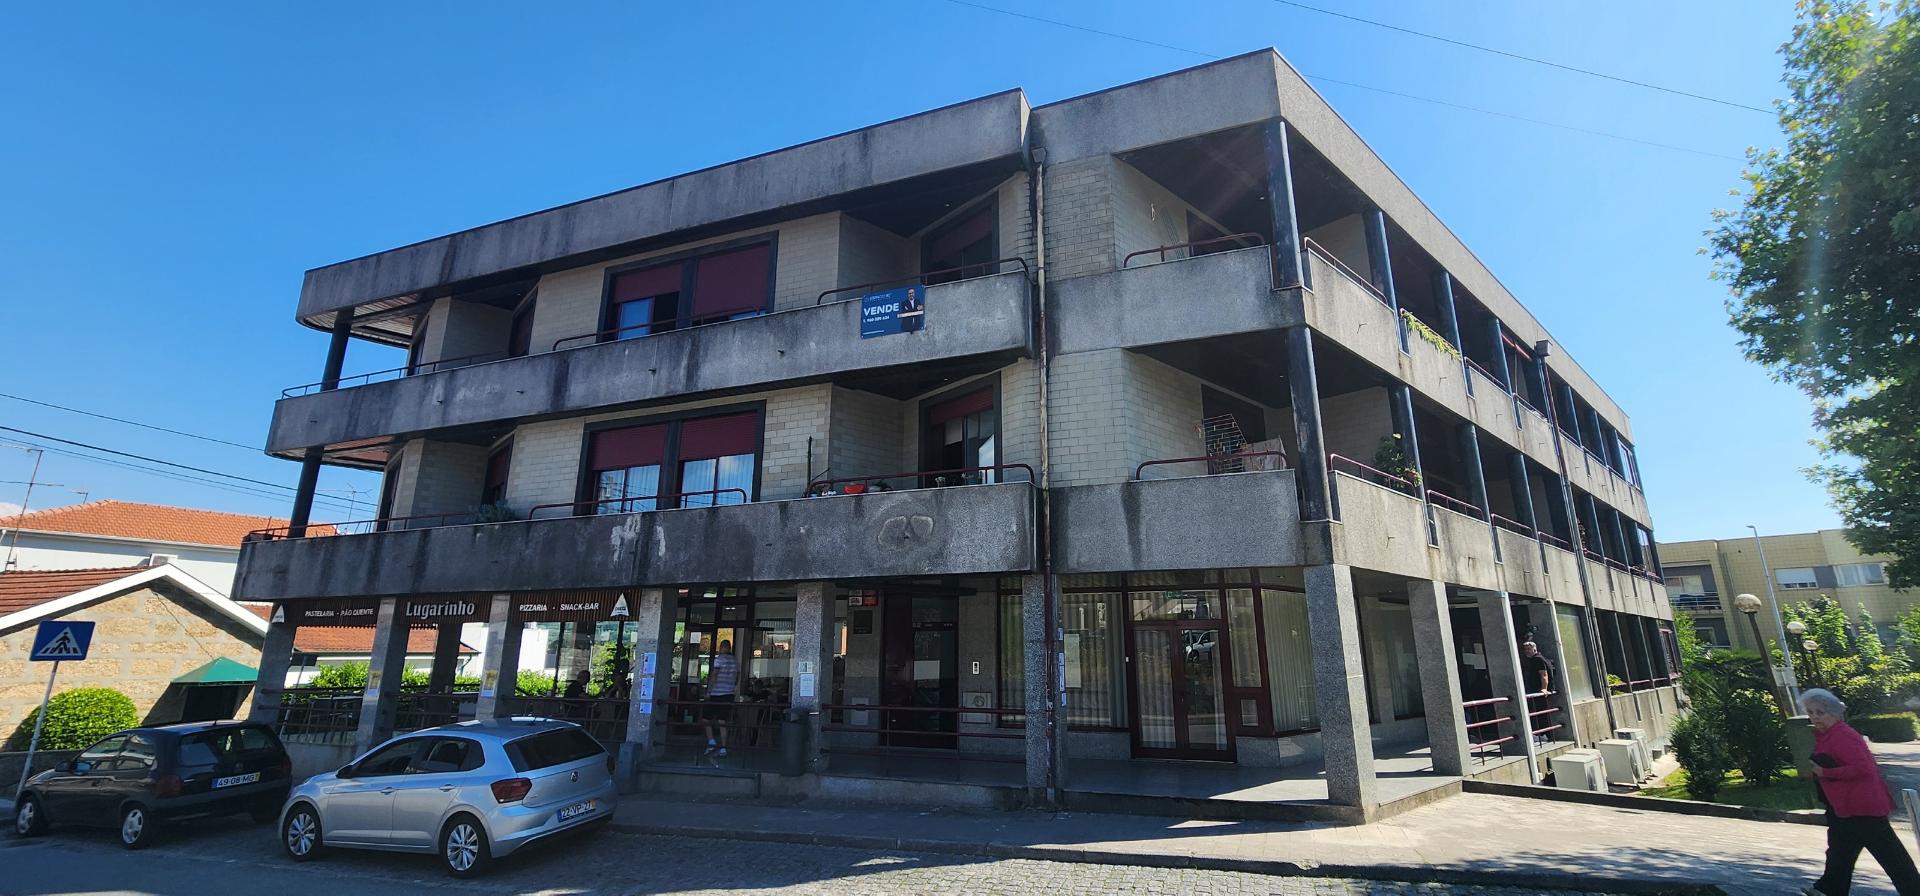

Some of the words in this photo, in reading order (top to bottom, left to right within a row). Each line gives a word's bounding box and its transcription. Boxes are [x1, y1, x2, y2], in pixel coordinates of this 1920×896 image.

[863, 302, 899, 316] VENDE
[340, 608, 352, 617] PÃO
[353, 608, 374, 616] QUENTE
[405, 601, 475, 620] Lugarinho
[519, 604, 548, 612] PIZZARIA
[560, 602, 600, 611] SNACK-BAR
